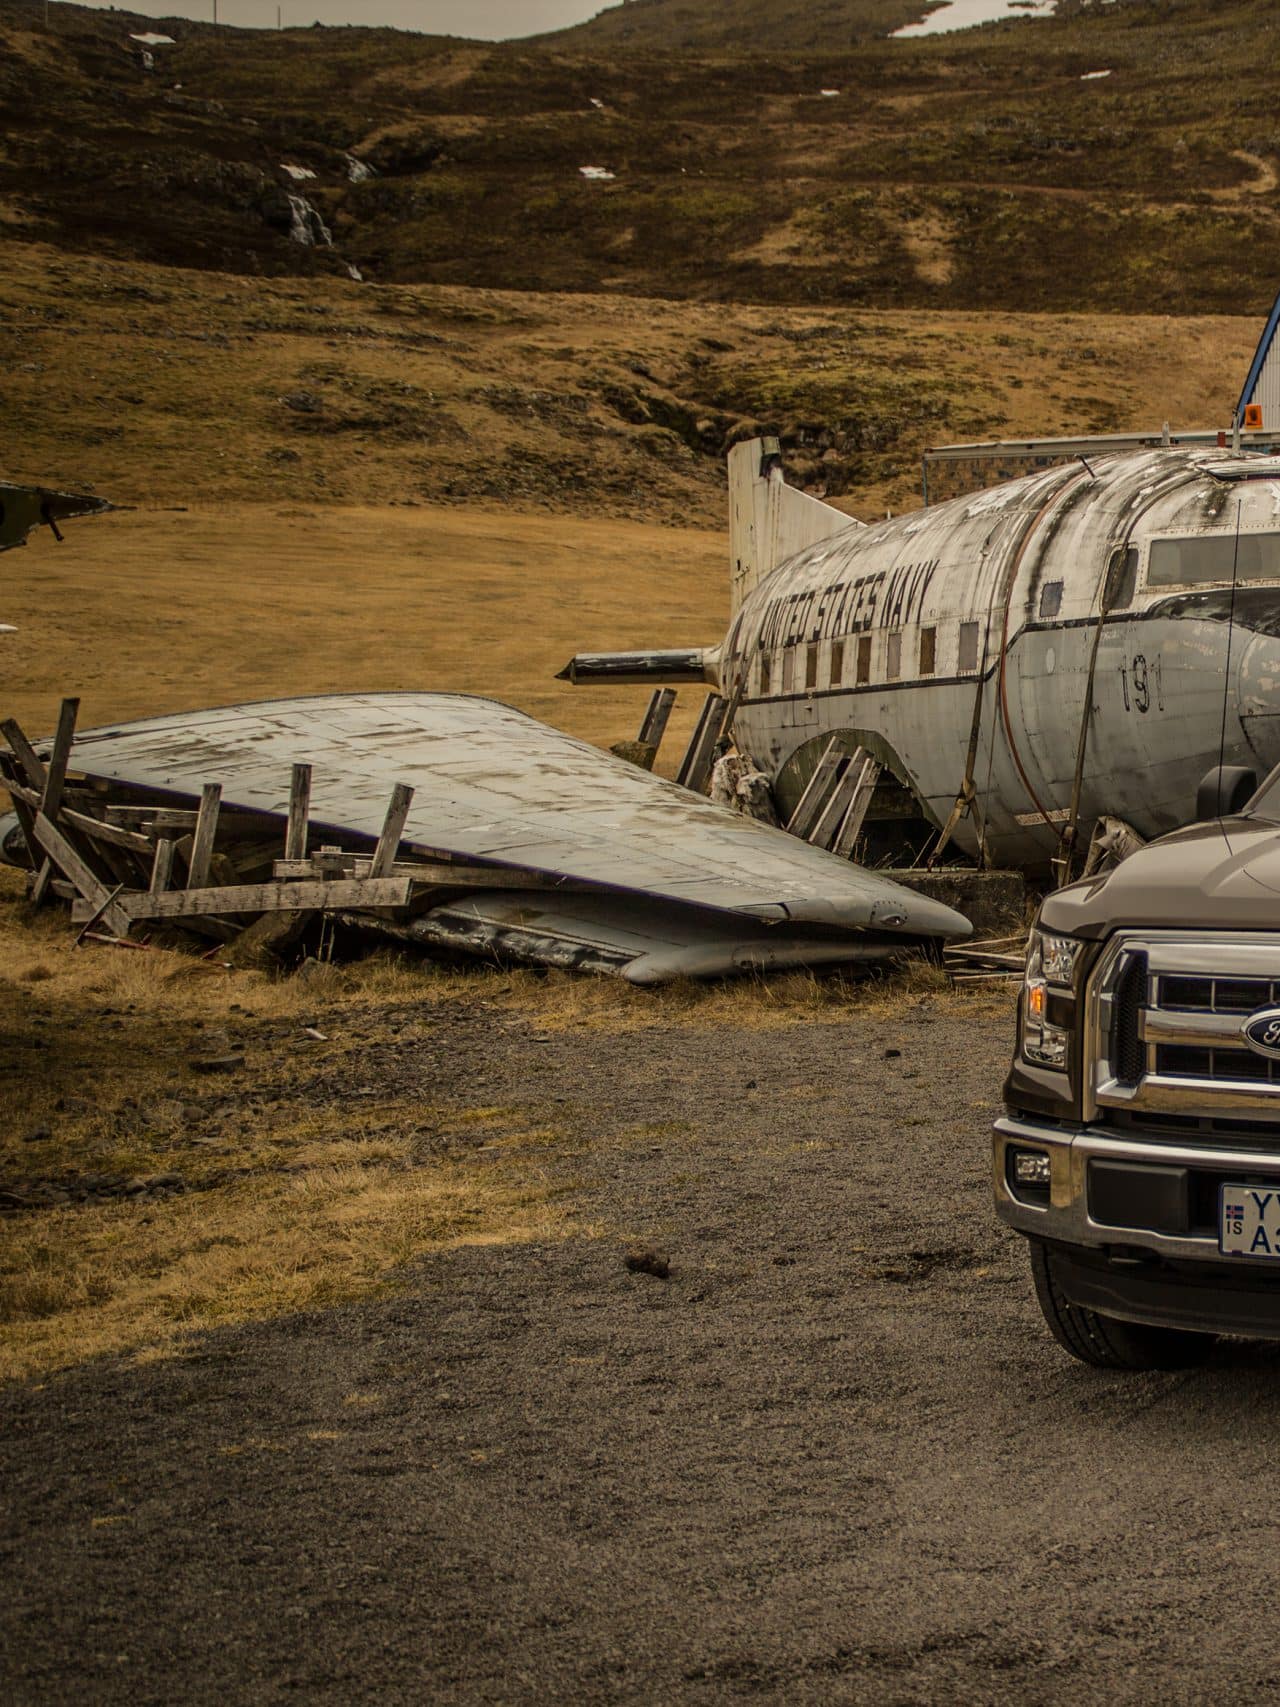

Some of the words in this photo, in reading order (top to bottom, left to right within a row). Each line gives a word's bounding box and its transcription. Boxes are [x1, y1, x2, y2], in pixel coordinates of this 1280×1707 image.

[758, 591, 816, 650] UNITED
[812, 570, 887, 641] STATES
[879, 558, 941, 629] NAVY
[1226, 1220, 1243, 1235] IS
